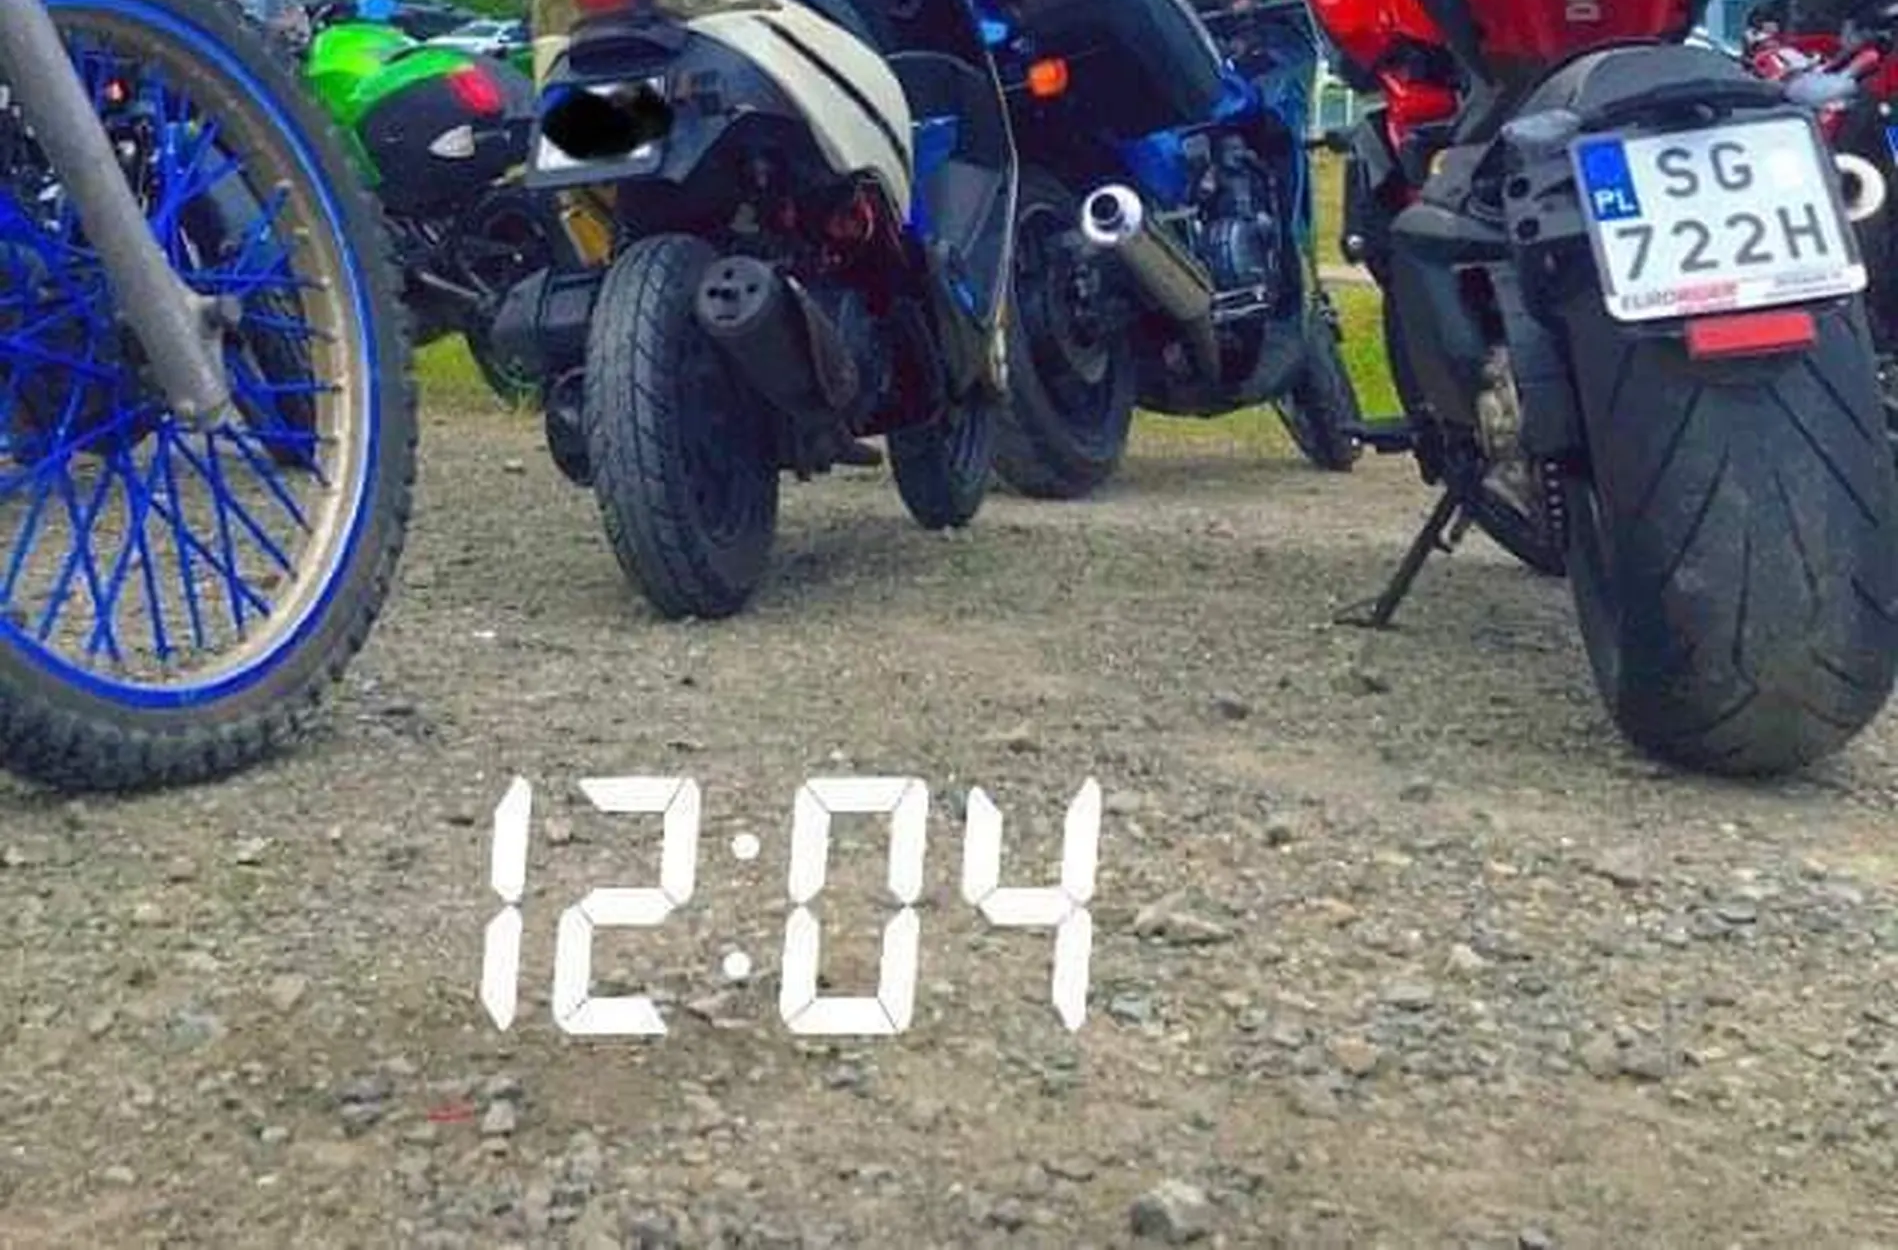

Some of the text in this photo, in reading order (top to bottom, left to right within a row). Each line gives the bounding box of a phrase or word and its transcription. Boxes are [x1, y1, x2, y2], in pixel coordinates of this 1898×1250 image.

[1656, 142, 1753, 198] SG
[1593, 189, 1635, 214] PL
[1616, 203, 1829, 281] 722H
